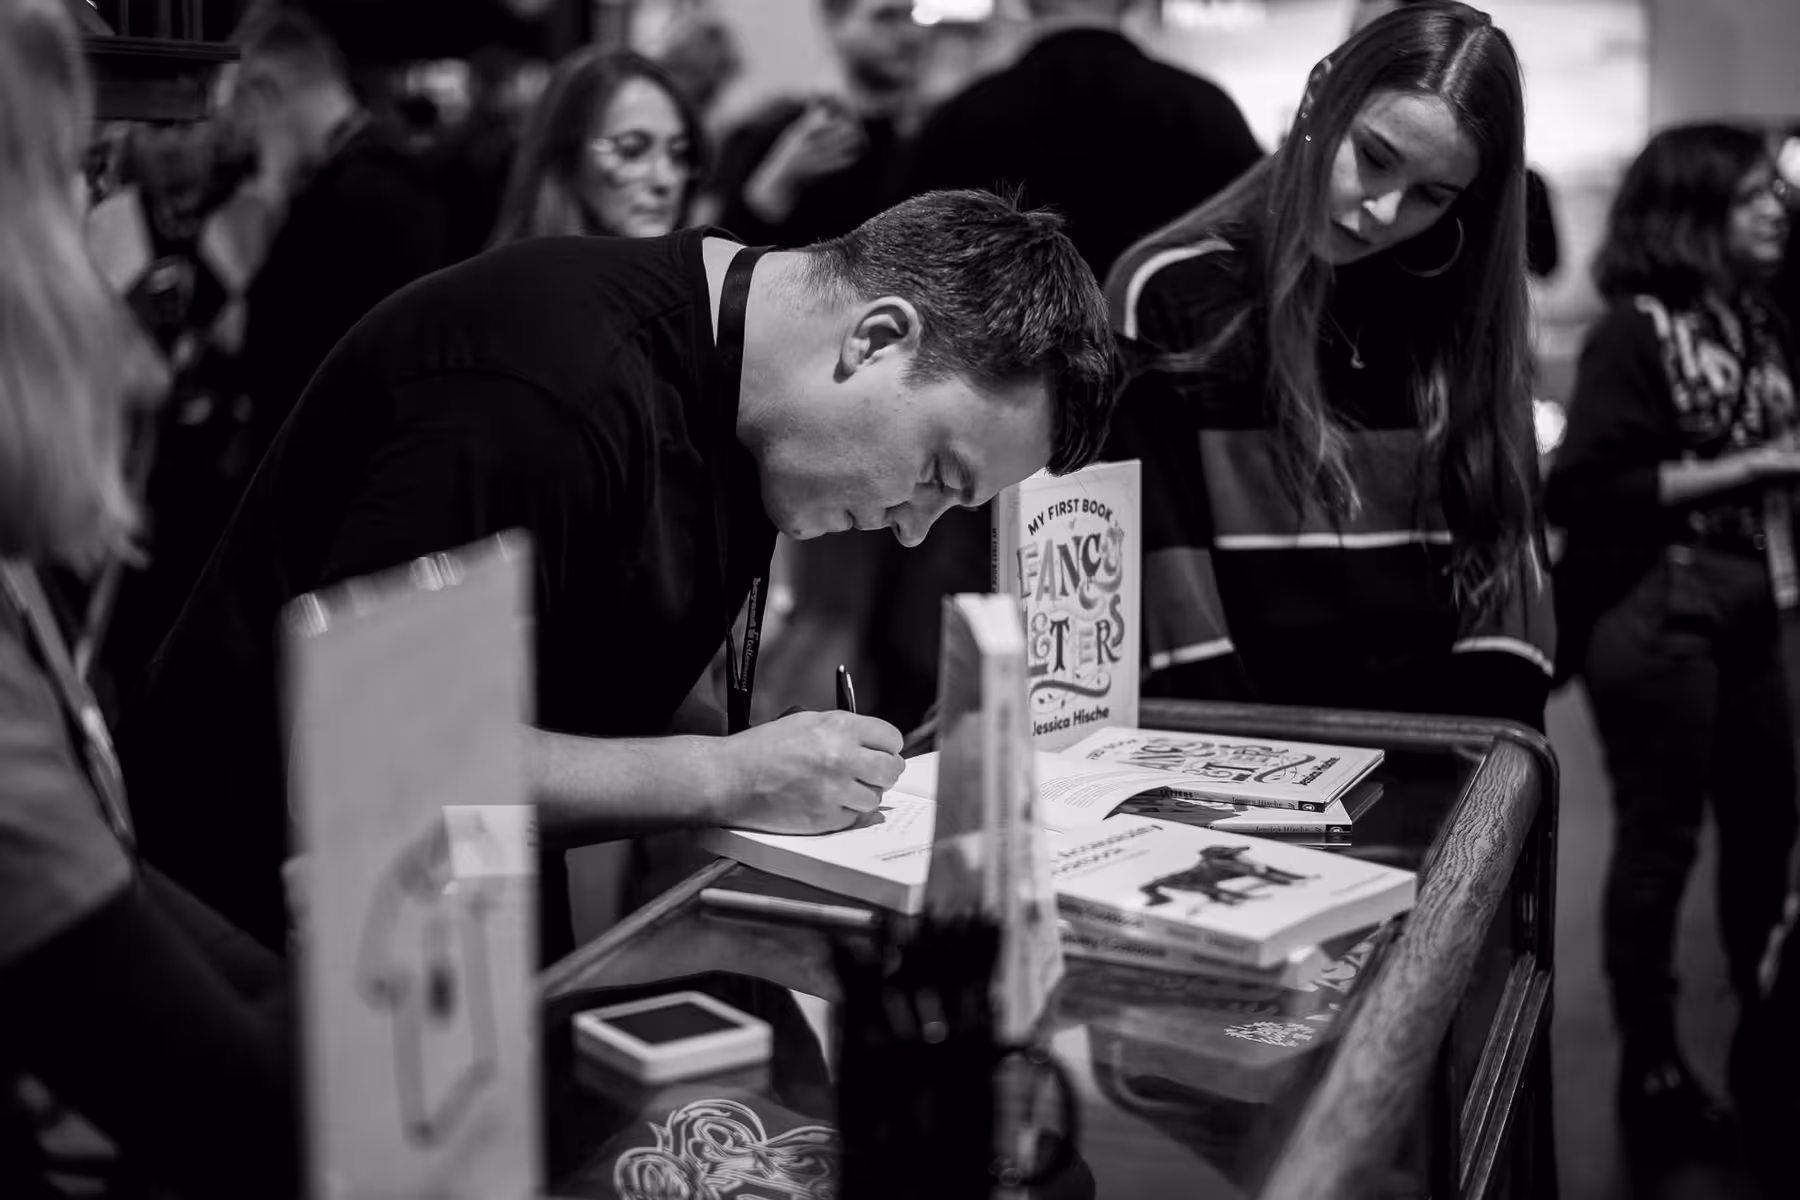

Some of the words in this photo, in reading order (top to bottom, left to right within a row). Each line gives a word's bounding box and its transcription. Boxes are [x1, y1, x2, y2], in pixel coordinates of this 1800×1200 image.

[1028, 515, 1046, 536] MY
[1048, 498, 1080, 521] FIRST
[1082, 499, 1113, 522] BOOK
[1016, 526, 1125, 611] FANCY
[1032, 711, 1071, 737] Jessica
[1073, 705, 1110, 728] Hische
